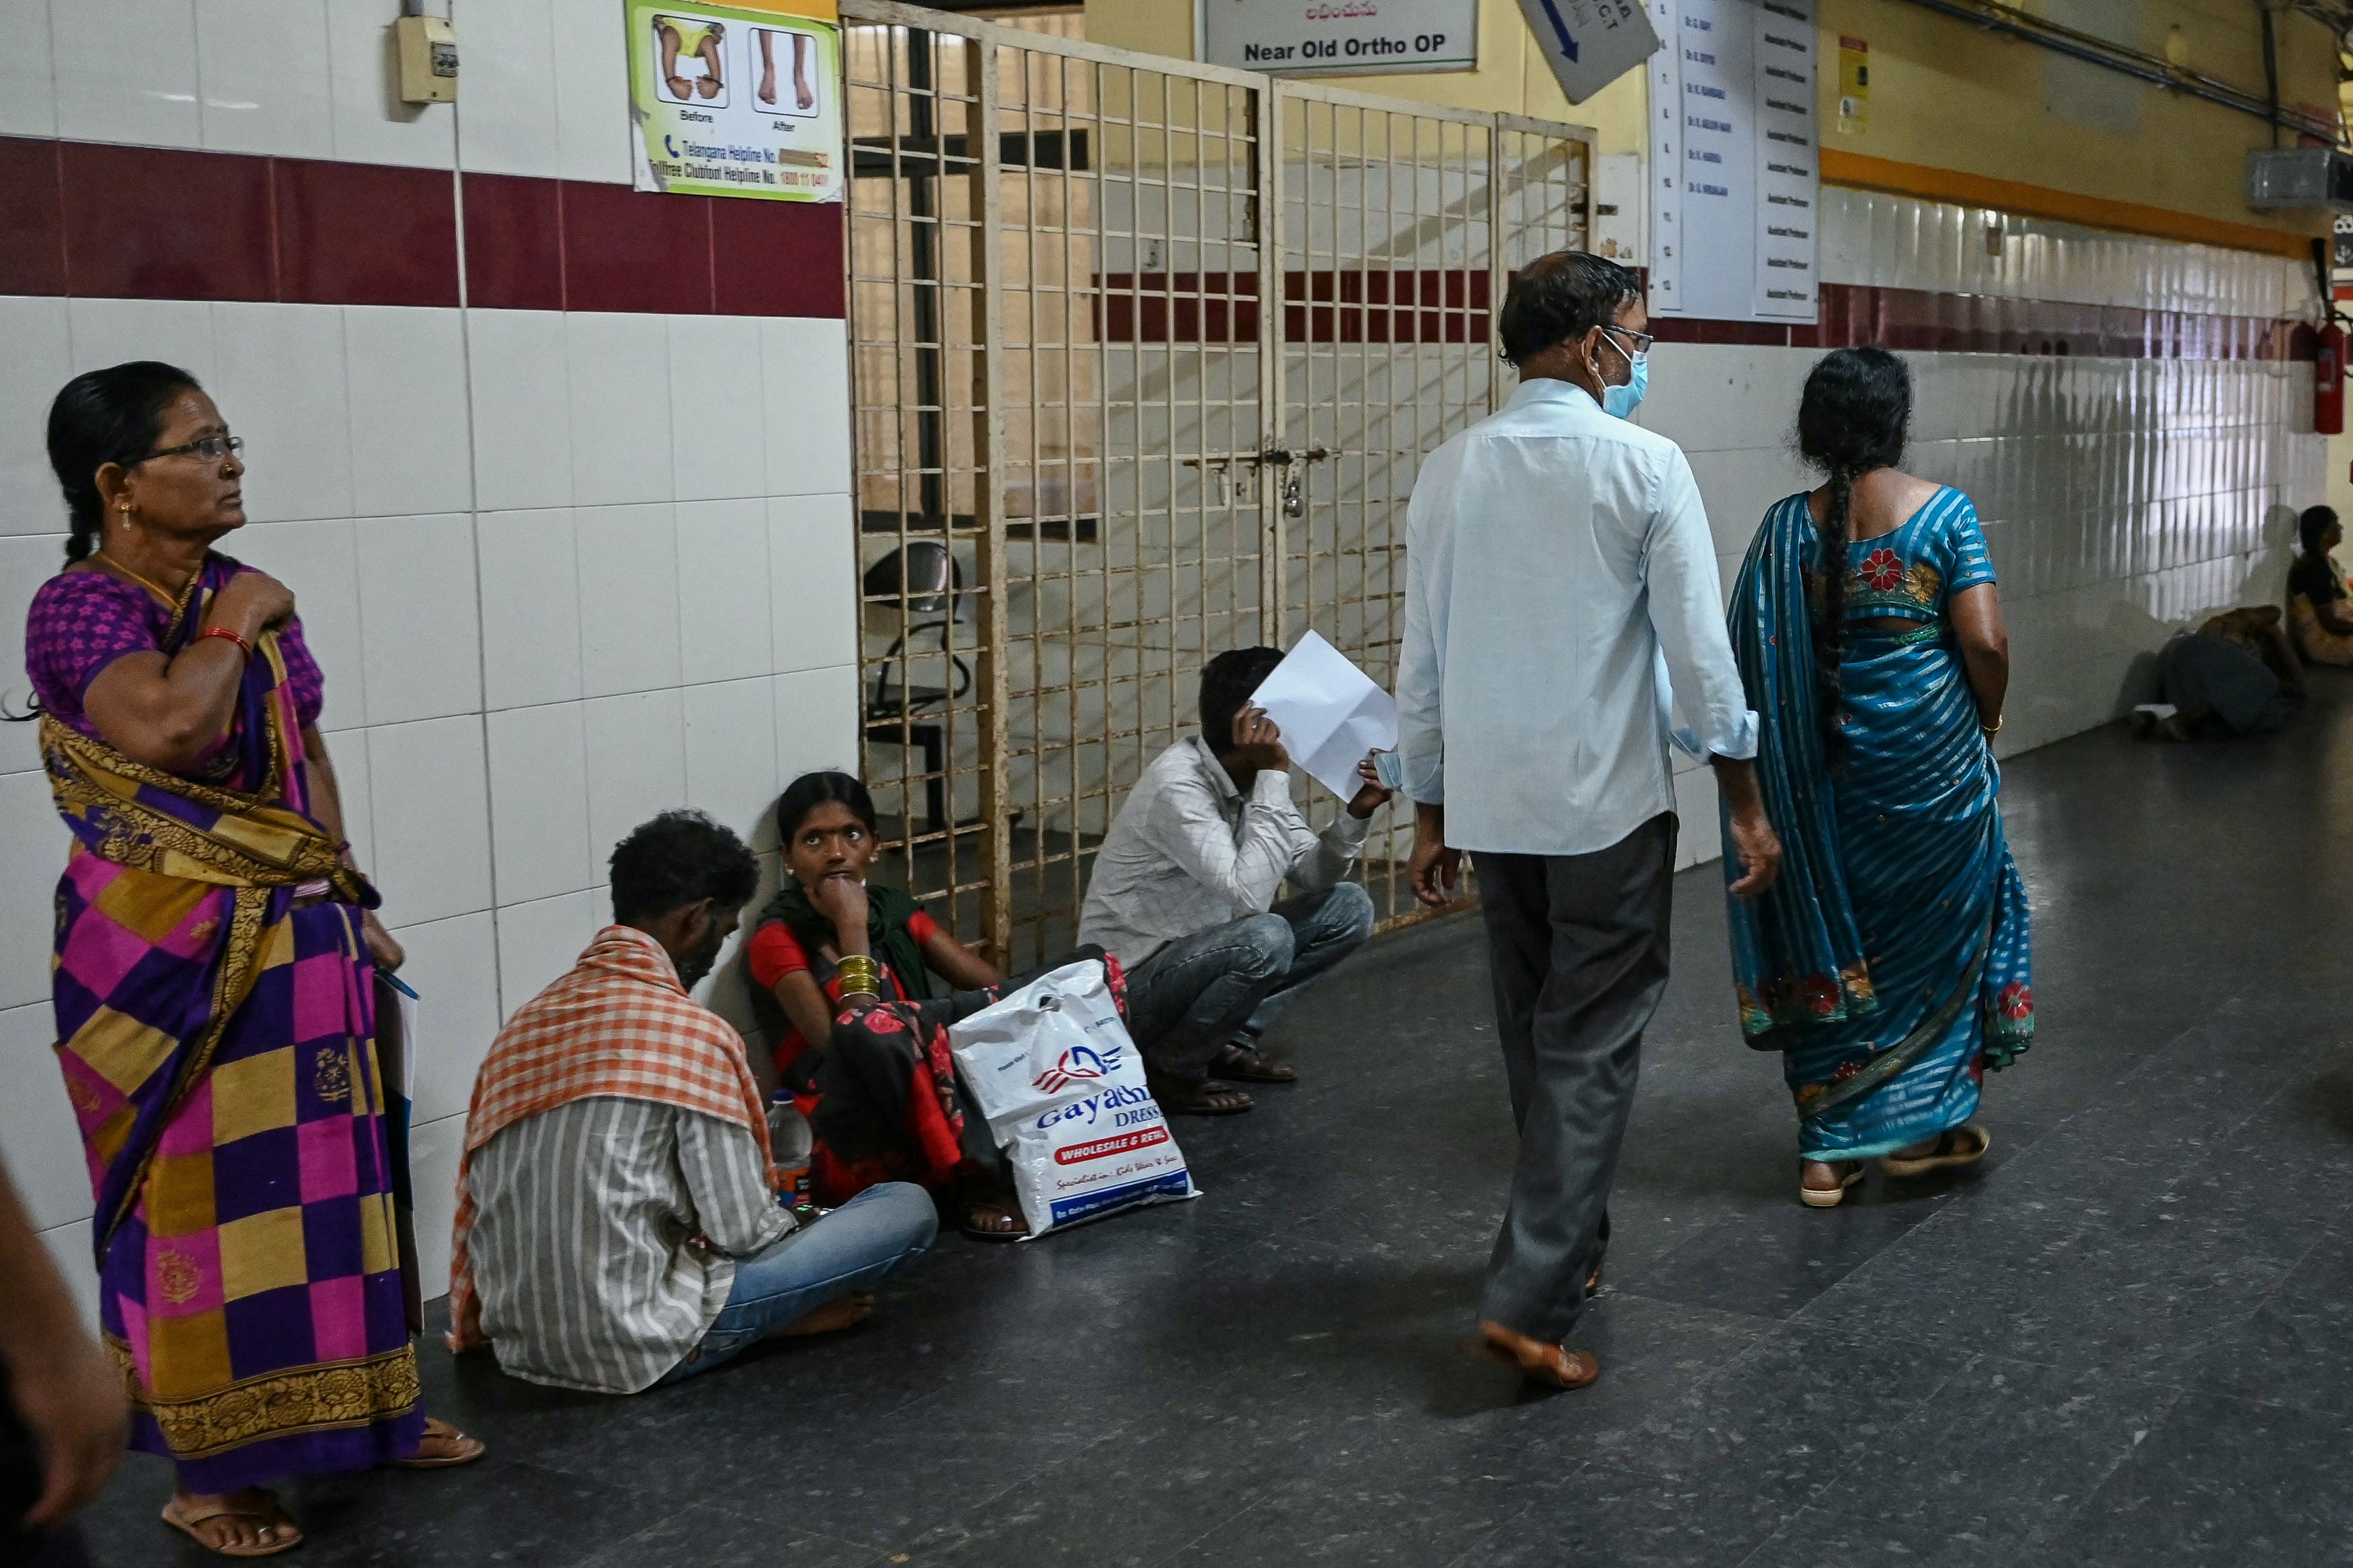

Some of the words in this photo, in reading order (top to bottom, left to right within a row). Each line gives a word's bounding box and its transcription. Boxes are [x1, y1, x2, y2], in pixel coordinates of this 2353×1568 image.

[1244, 44, 1295, 61] Near
[1302, 39, 1337, 58] Old
[1345, 37, 1406, 56] Ortho
[1415, 34, 1445, 52] OP
[680, 109, 714, 123] Before
[772, 120, 796, 132] After
[682, 140, 727, 162] Telangana
[728, 145, 761, 165] Helpline
[724, 166, 760, 184] Helpline
[1036, 1085, 1152, 1128] Gayath
[1115, 1105, 1163, 1127] DRESS
[1061, 1138, 1129, 1161] WHOLESALE
[1130, 1135, 1139, 1145] &
